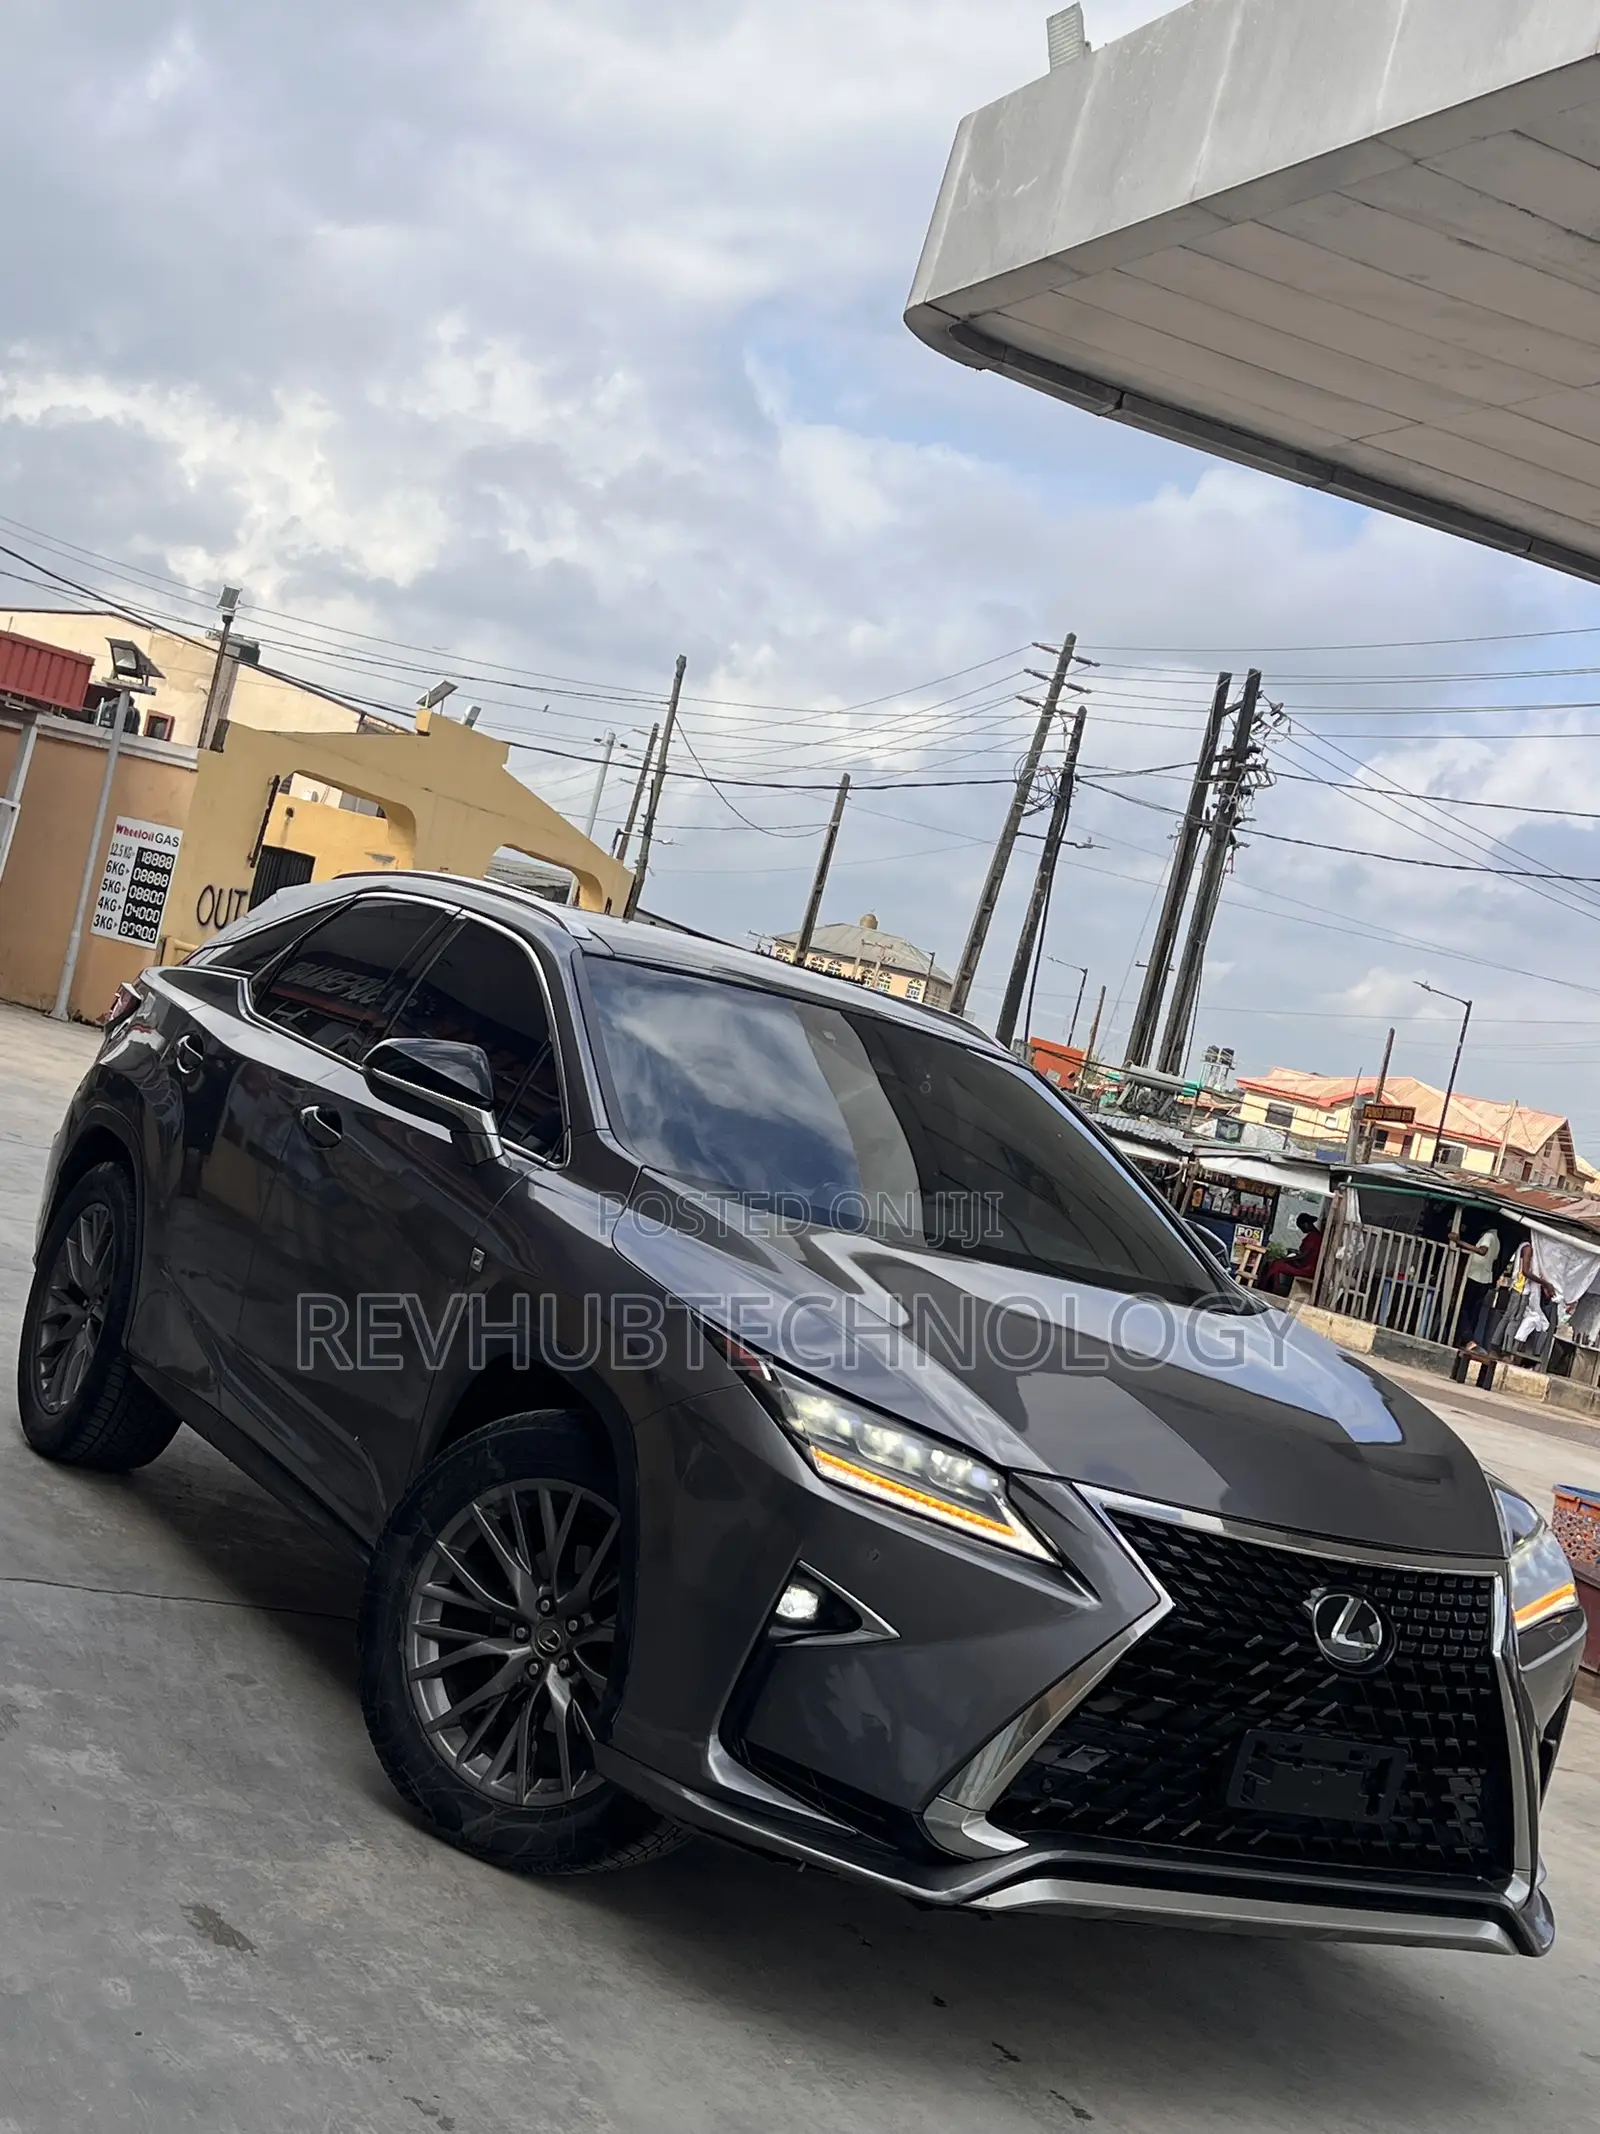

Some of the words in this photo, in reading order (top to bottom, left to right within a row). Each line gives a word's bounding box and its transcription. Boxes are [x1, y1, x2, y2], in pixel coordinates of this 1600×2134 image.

[155, 832, 180, 848] GAS
[105, 859, 126, 876] 6KG
[101, 878, 121, 895] 5KG
[97, 896, 117, 912] 4KG
[196, 884, 249, 929] OUT
[93, 914, 113, 931] 3KG
[1237, 1226, 1260, 1240] POS
